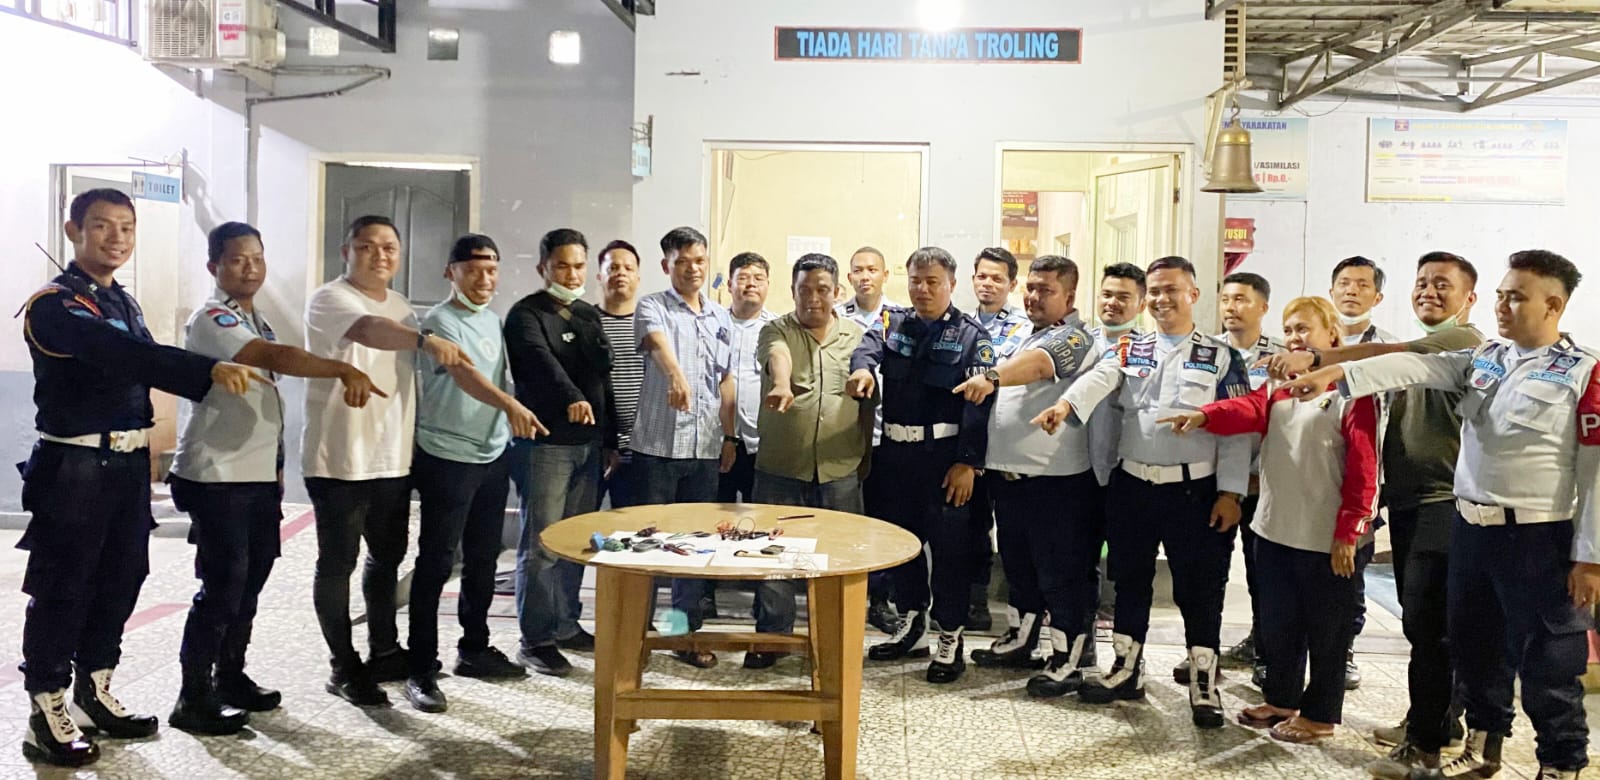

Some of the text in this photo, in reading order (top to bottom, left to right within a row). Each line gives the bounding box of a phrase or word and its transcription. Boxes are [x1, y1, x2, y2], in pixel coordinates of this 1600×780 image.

[797, 31, 1059, 59] TIADA HARI TANPA TROLING
[148, 181, 175, 195] TOILET
